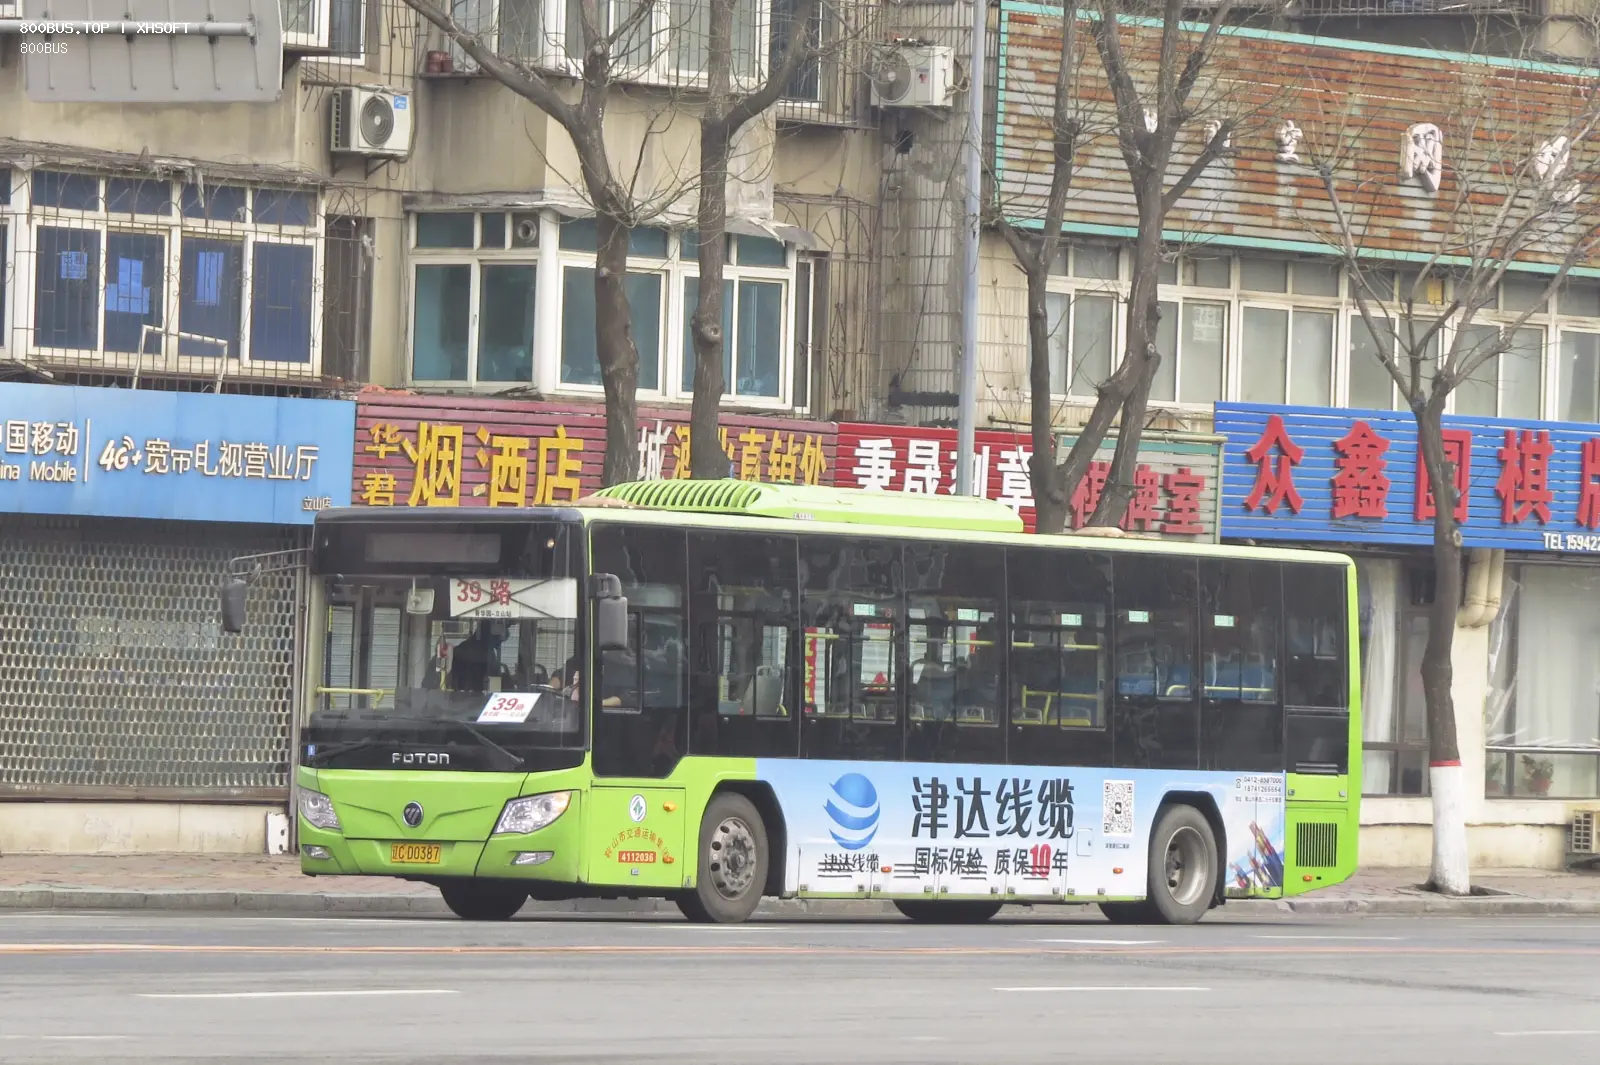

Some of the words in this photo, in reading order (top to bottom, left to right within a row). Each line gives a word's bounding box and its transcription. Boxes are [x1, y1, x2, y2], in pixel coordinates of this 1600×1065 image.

[30, 460, 77, 482] Mobile
[402, 422, 584, 507] 烟酒店
[392, 752, 450, 764] FOTON
[911, 776, 1075, 839] 津达线缆
[620, 851, 655, 862] 4112036
